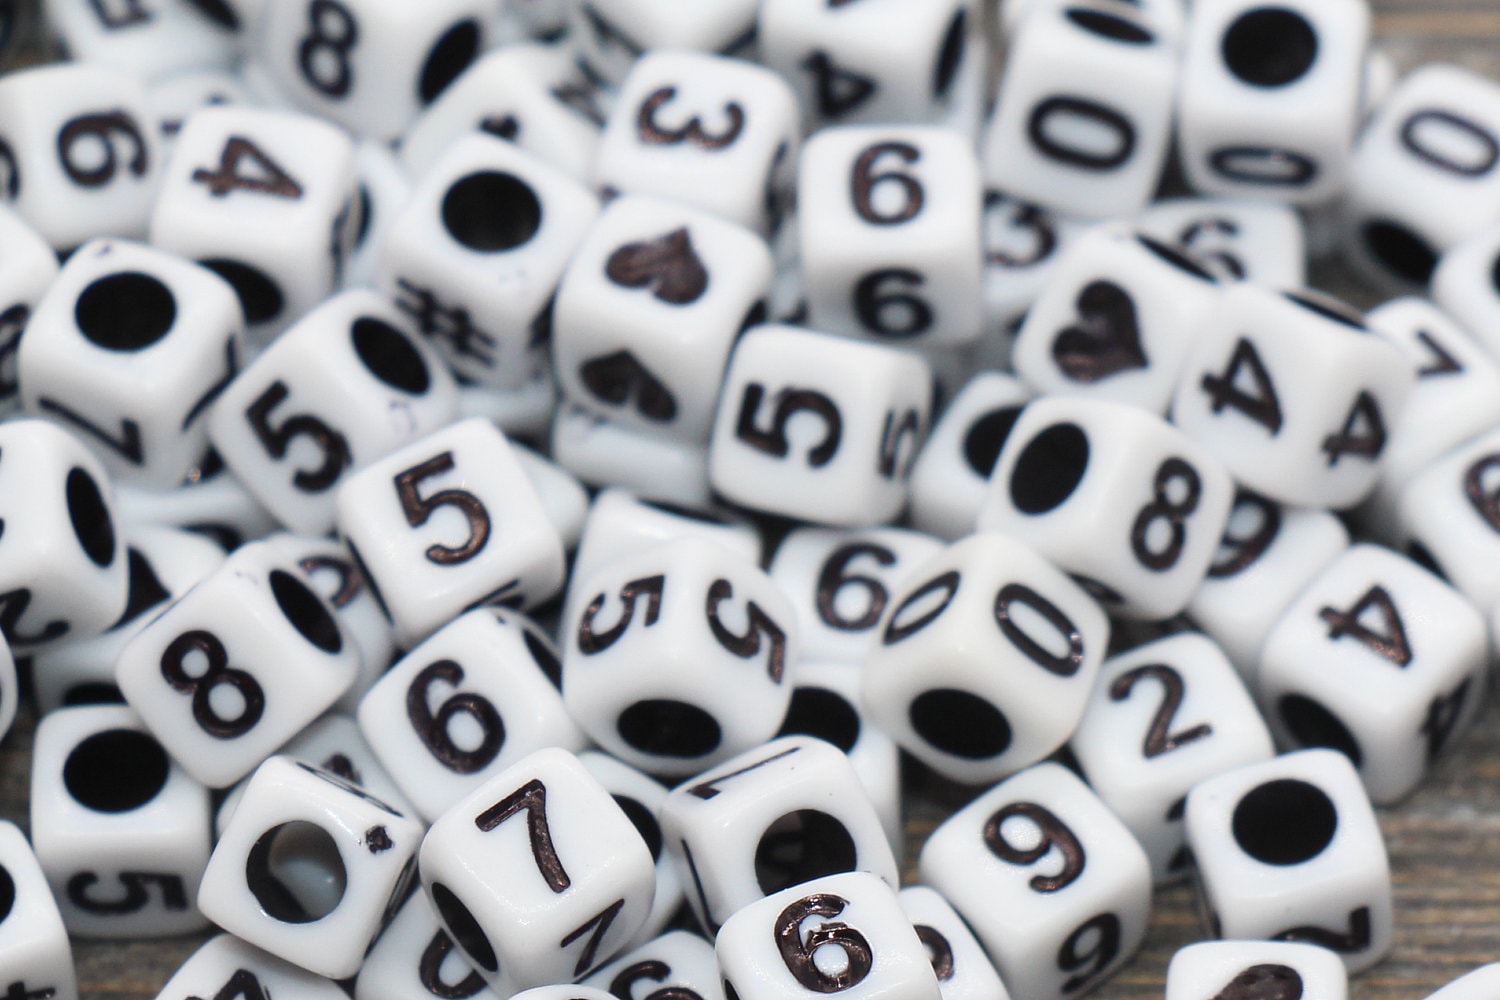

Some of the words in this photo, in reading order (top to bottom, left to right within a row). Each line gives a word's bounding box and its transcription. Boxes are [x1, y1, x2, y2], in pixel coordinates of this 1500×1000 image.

[296, 0, 359, 101] 8
[808, 50, 878, 118] 4
[635, 86, 745, 150] 3
[1025, 94, 1138, 173] 0
[192, 136, 303, 199] 4
[849, 141, 925, 226] 6
[847, 267, 936, 344] 6
[734, 383, 842, 468] 5
[1200, 338, 1283, 435] 4
[1321, 390, 1388, 466] 4
[245, 380, 352, 495] 5
[393, 451, 491, 566] 5
[1130, 457, 1202, 573] 8
[577, 575, 664, 656] 5
[815, 538, 896, 631] 6
[882, 570, 960, 646] 0
[994, 583, 1084, 677] 0
[1318, 585, 1413, 668] 4
[706, 579, 786, 684] 5
[160, 630, 265, 740] 8
[406, 659, 506, 774] 6
[1107, 663, 1211, 758] 2
[475, 779, 571, 893] 7
[983, 801, 1086, 893] 9
[68, 870, 190, 915] 5
[774, 894, 873, 994] 6
[1057, 913, 1120, 994] 9
